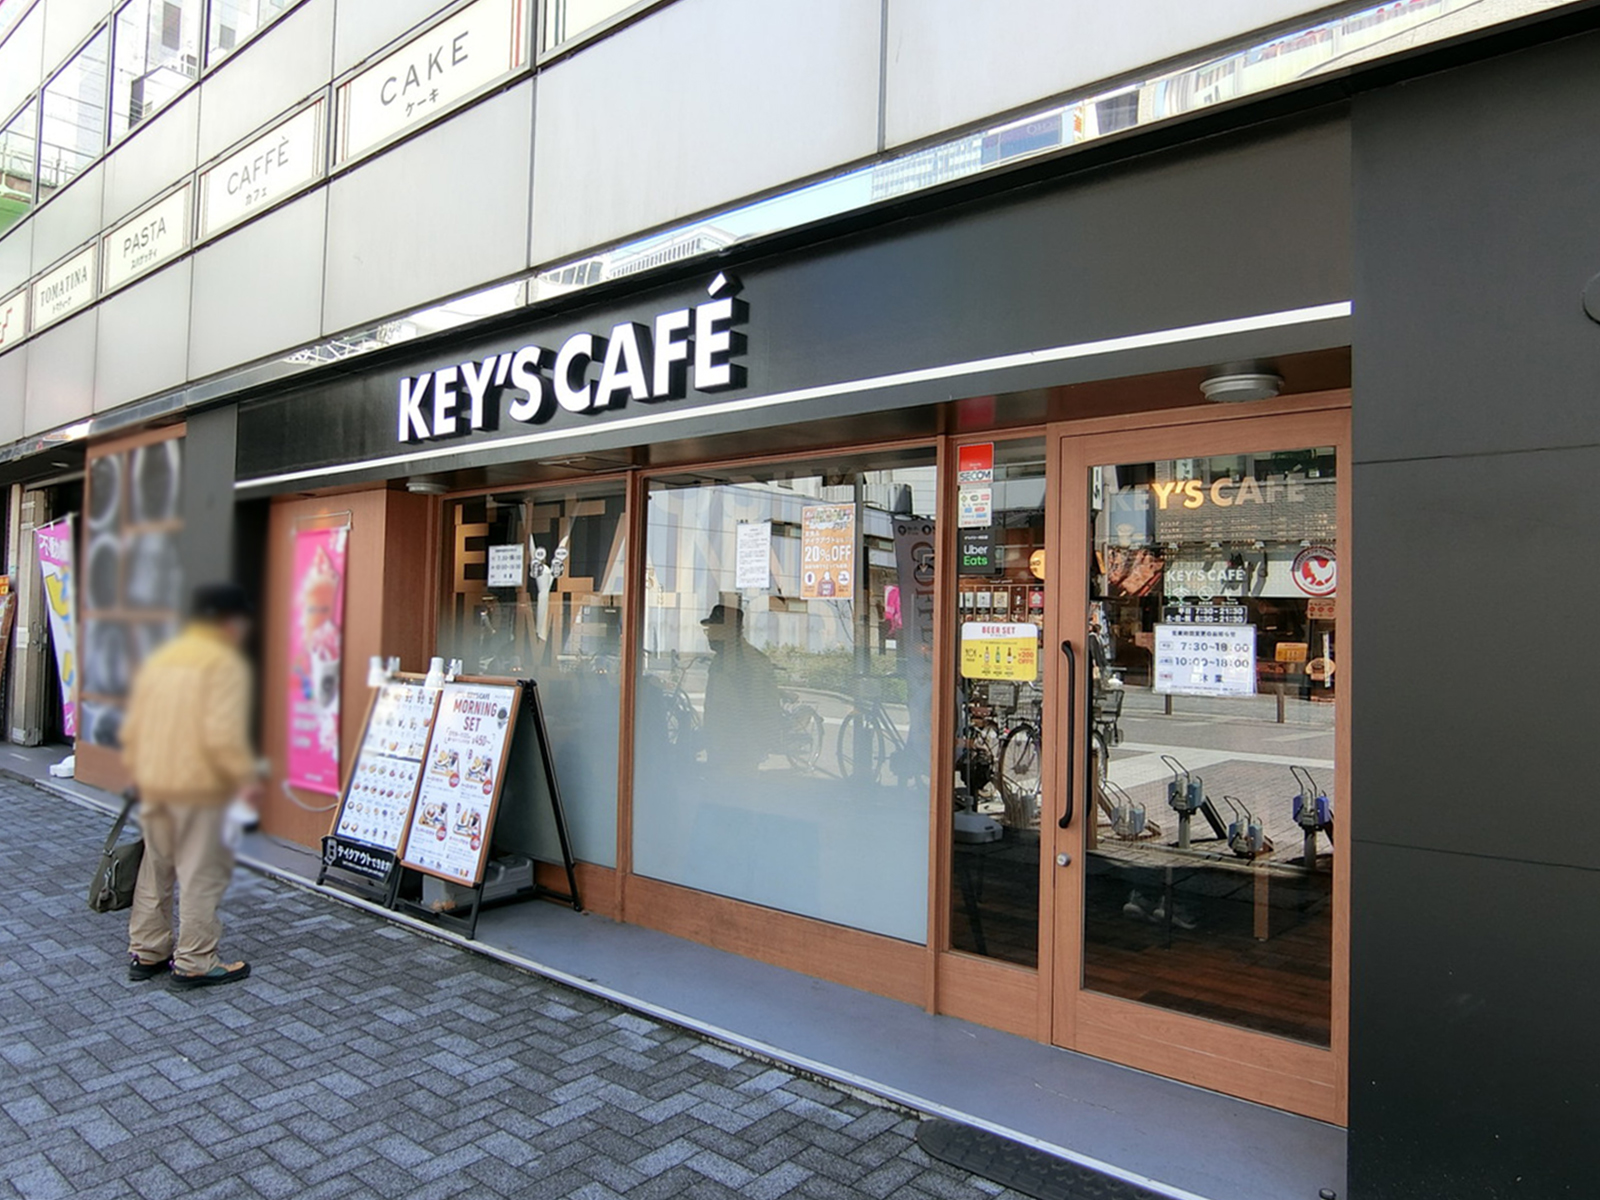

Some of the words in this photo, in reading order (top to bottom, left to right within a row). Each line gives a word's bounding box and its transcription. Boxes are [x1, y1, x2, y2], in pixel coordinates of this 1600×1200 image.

[381, 30, 468, 106] CAKE
[405, 88, 439, 118] ケーキ
[227, 136, 289, 195] CAFFÈ
[123, 217, 166, 258] PASTA
[40, 265, 88, 308] TOMATINA
[398, 345, 545, 442] KEY'S
[553, 271, 734, 413] CAFÉ
[960, 470, 992, 482] SECOM
[963, 544, 989, 555] Uber
[963, 555, 989, 567] Eats
[1167, 569, 1205, 582] KEY'S
[1002, 627, 1016, 635] SET
[453, 699, 498, 717] MORNING
[463, 716, 482, 732] SET
